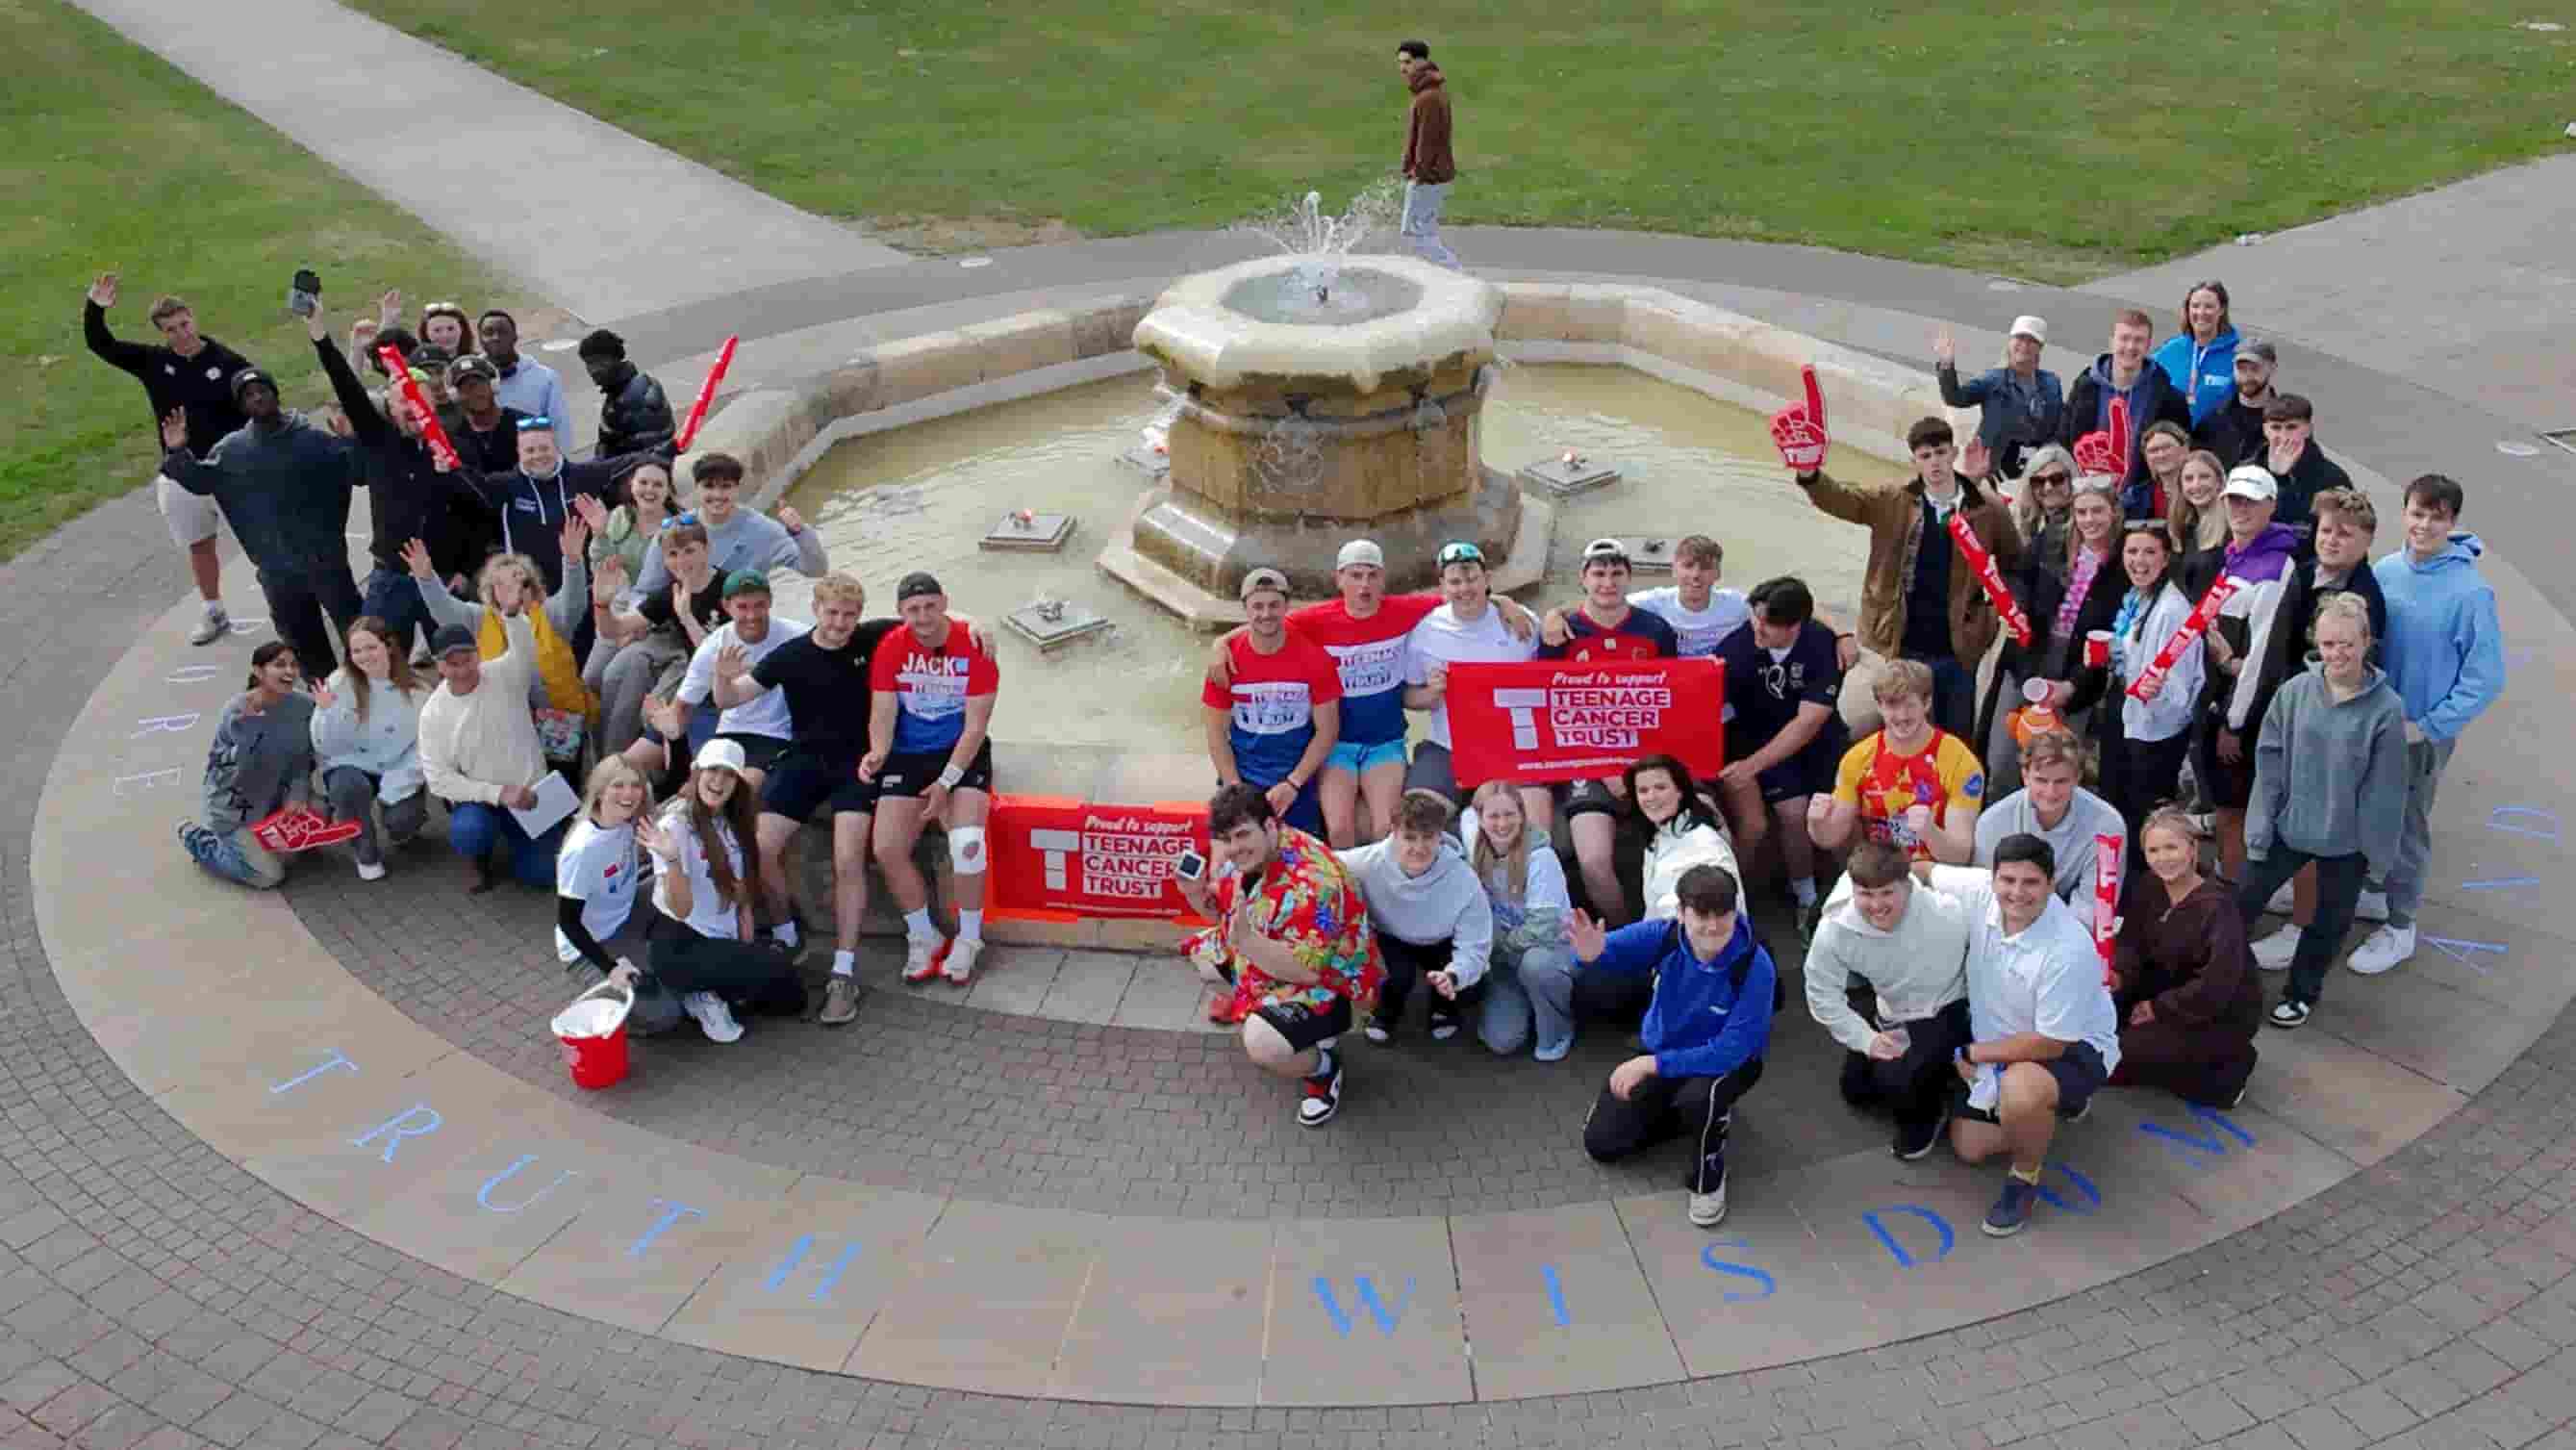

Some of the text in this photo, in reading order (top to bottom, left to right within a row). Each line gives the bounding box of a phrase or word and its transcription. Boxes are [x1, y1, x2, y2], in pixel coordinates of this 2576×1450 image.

[900, 650, 956, 677] JACK
[1552, 671, 1594, 686] Proud
[1553, 689, 1669, 707] TEENAGE
[1553, 708, 1657, 726] CANCER
[1556, 728, 1633, 746] TRUST
[1084, 875, 1159, 896] TRUST
